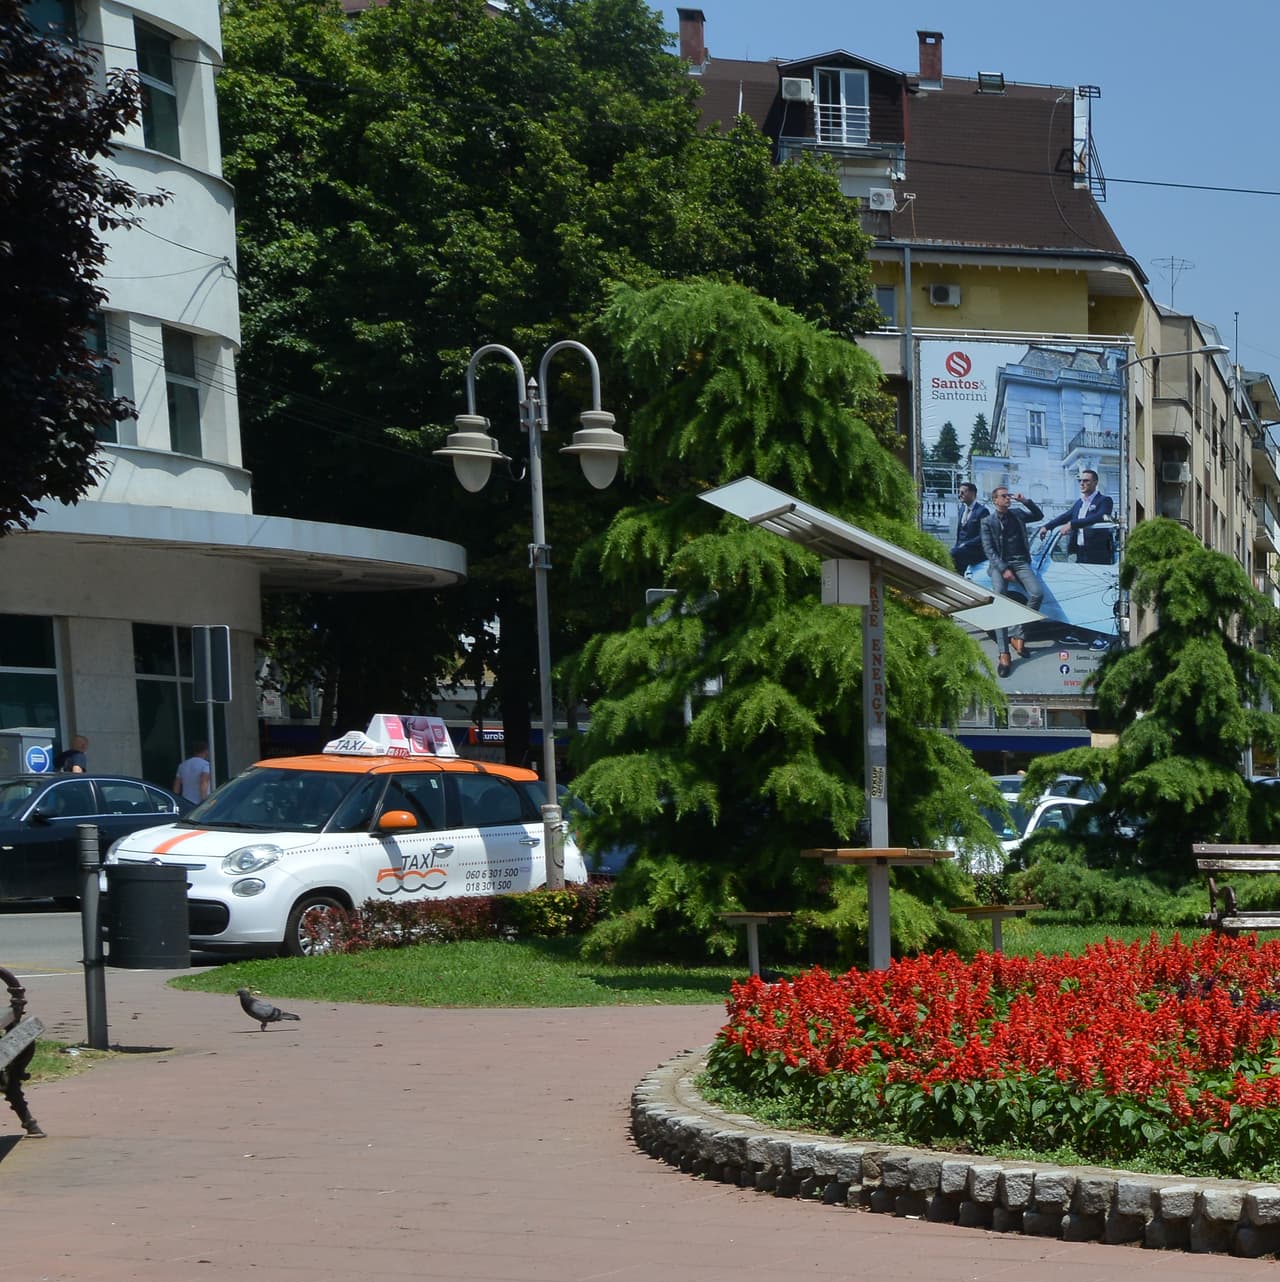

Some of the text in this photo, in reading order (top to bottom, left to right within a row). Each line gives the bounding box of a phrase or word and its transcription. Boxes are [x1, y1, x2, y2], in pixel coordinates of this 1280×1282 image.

[932, 390, 988, 402] Santorini
[871, 638, 884, 724] ENERGY
[335, 740, 367, 752] TAXI
[401, 853, 436, 870] TAXI
[465, 867, 519, 880] 060 6 301 500
[465, 880, 512, 892] 018 301 500
